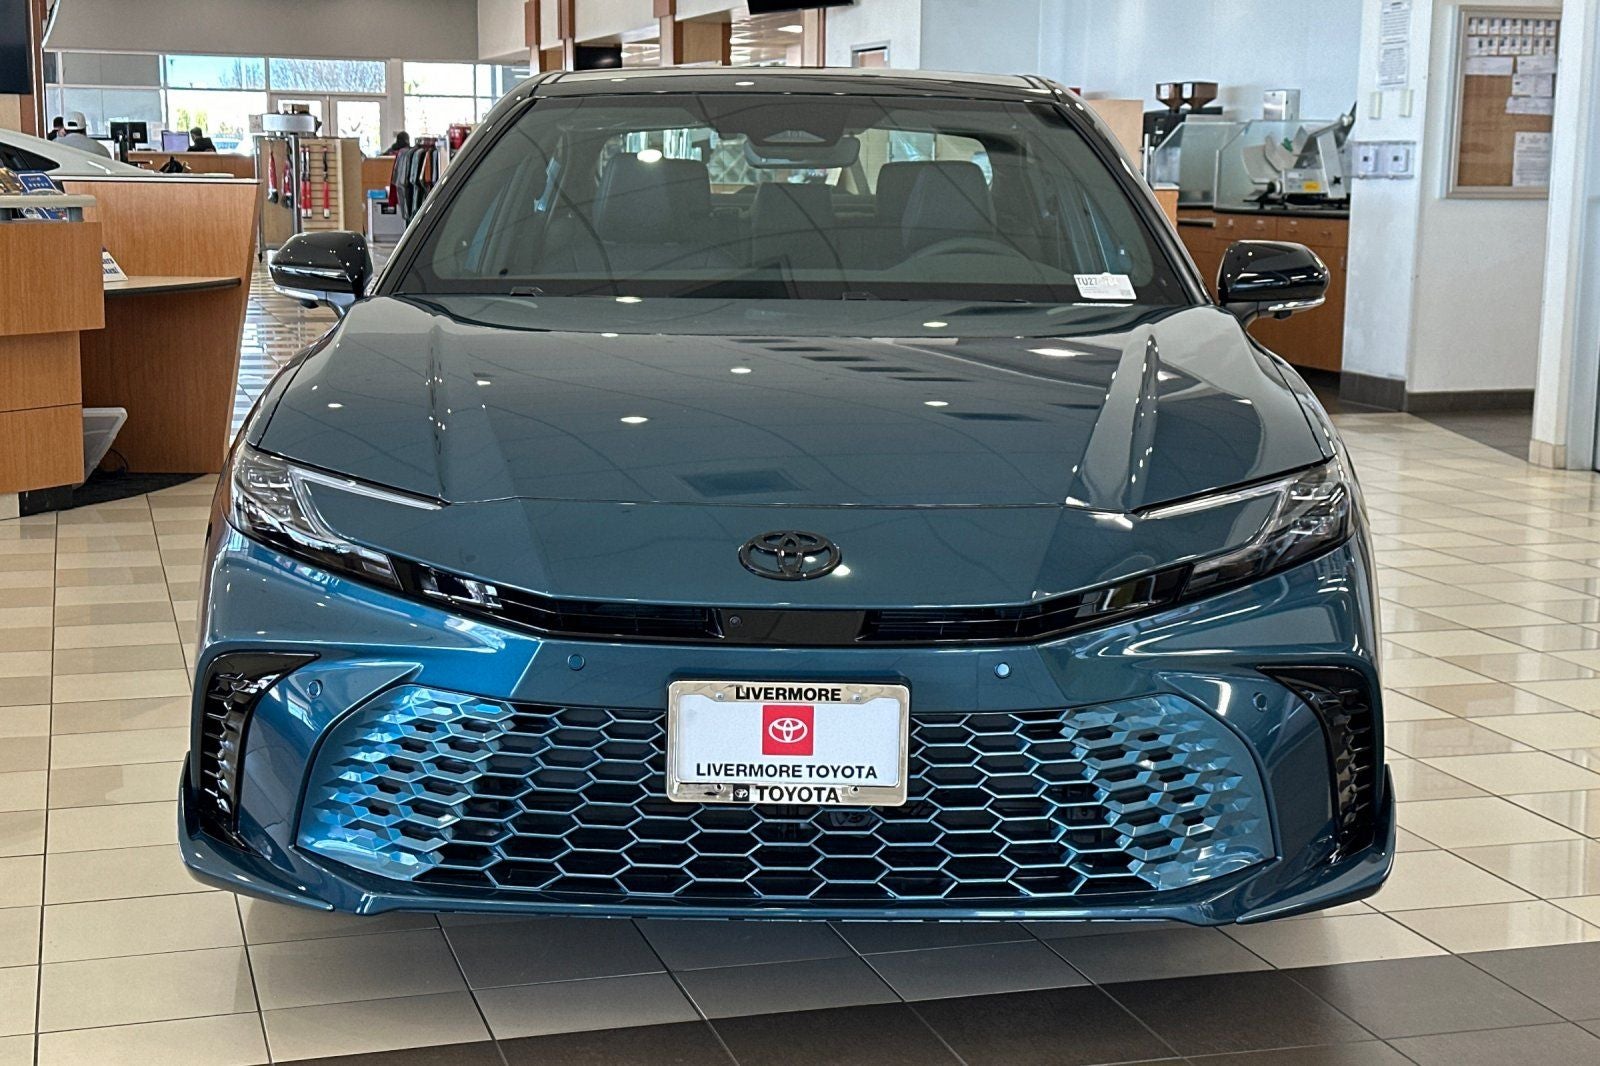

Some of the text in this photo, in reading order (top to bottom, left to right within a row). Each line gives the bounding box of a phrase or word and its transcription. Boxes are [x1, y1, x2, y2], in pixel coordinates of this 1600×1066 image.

[735, 687, 842, 702] LIVERMORE
[696, 763, 878, 779] LIVERMORE TOYOTA
[755, 785, 841, 803] TOYOTA
